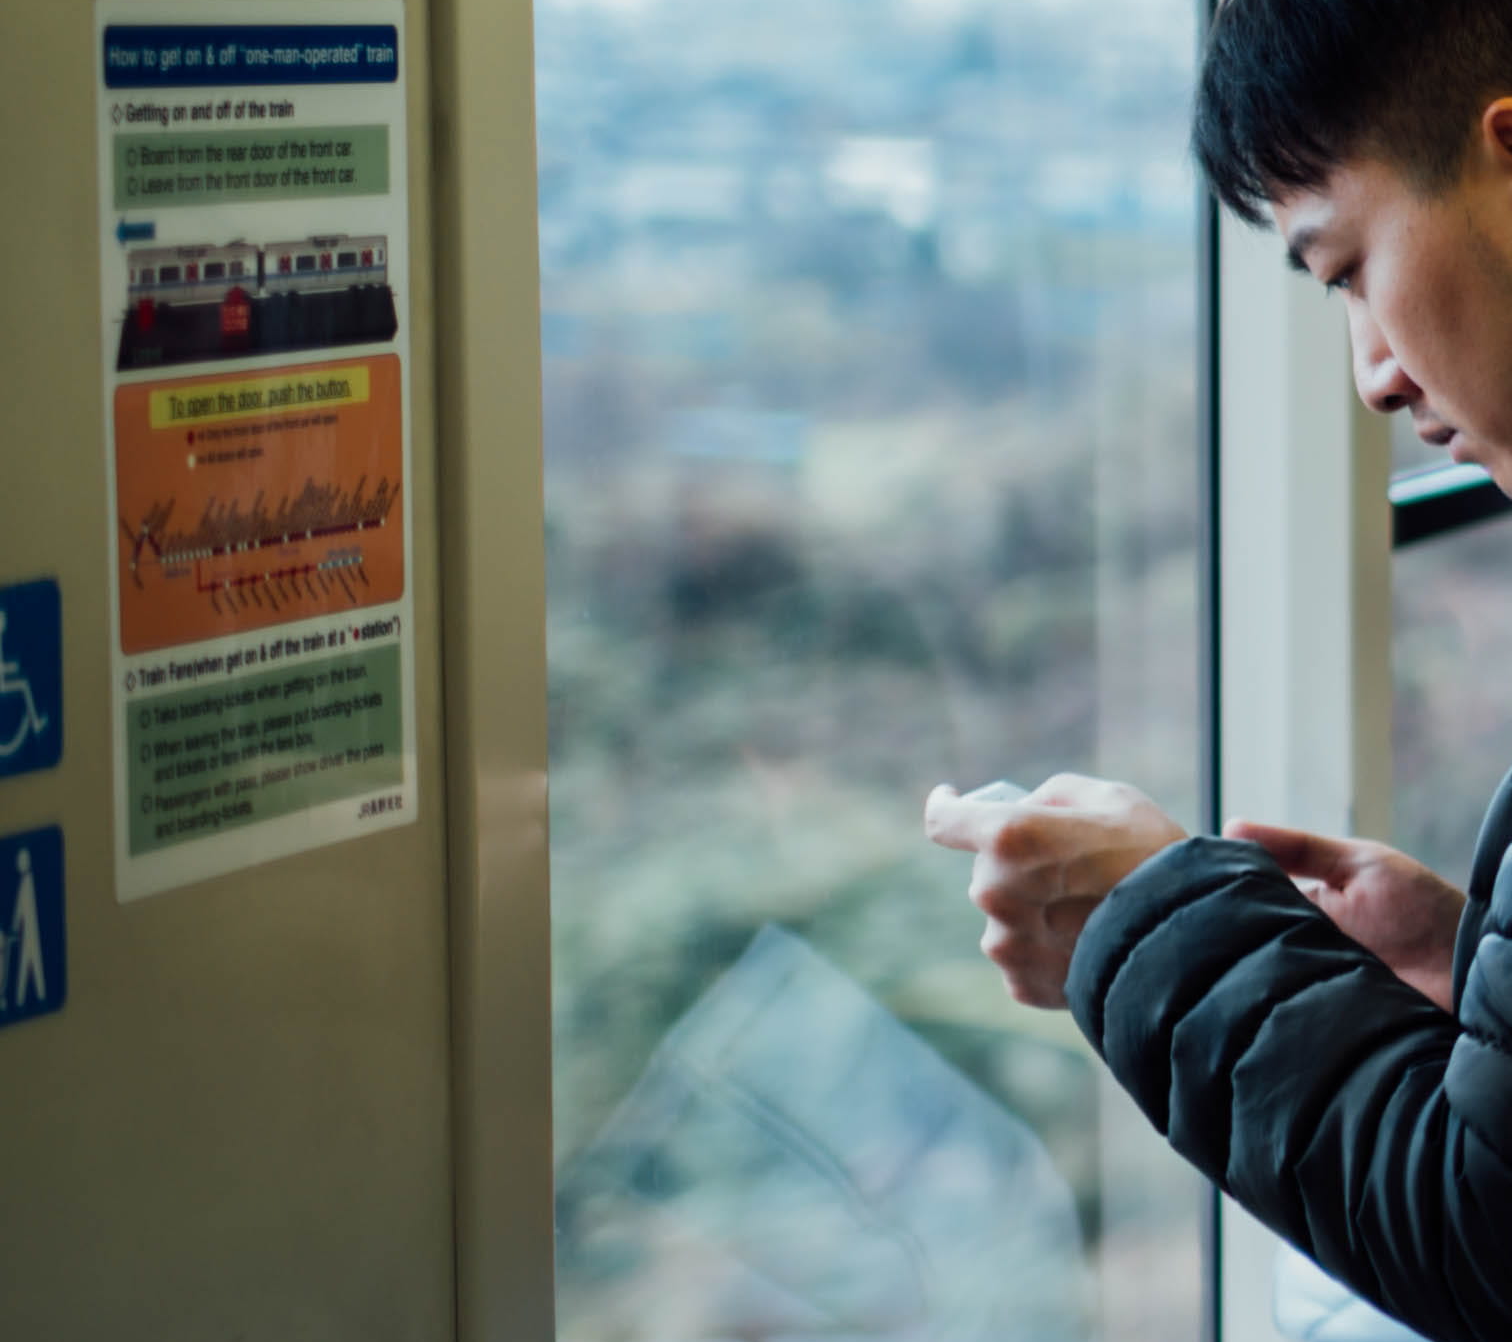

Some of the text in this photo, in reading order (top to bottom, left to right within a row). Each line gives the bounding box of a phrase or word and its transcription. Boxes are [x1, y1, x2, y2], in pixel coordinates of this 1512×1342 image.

[110, 45, 139, 67] How
[143, 47, 157, 66] to
[160, 46, 181, 71] get
[186, 50, 201, 66] on
[206, 44, 215, 65] &
[219, 44, 237, 66] off
[366, 43, 394, 64] train
[127, 98, 294, 126] Getting on and off of the train
